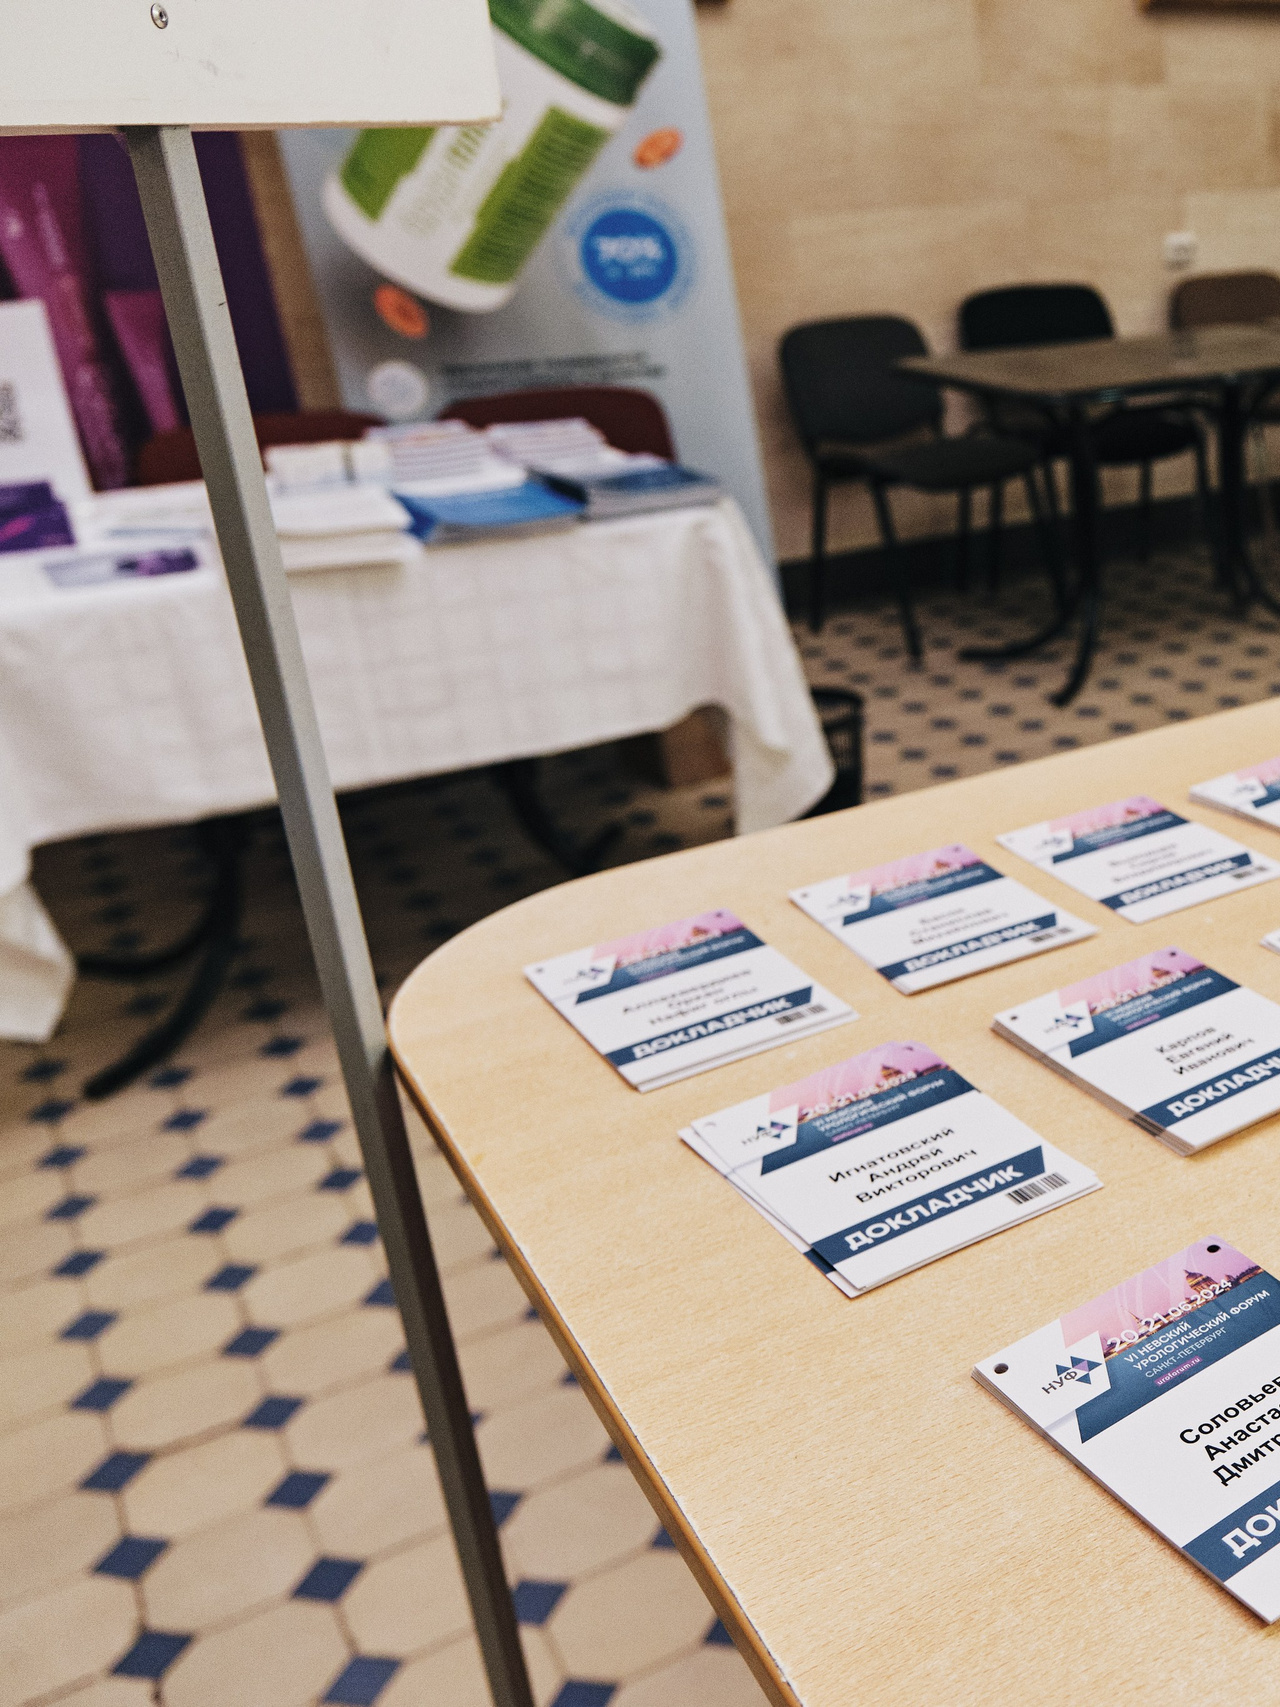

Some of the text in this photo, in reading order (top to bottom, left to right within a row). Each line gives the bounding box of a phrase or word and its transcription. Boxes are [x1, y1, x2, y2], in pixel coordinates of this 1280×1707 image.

[633, 998, 793, 1059] ДОКЛАДЧИК
[1156, 1026, 1216, 1054] Карпов
[1166, 1033, 1234, 1063] Евгений
[1173, 1038, 1254, 1075] Иванович
[829, 1126, 955, 1184] Игнатовский
[856, 1149, 977, 1204] Викторович
[869, 1146, 944, 1182] Андрей
[844, 1164, 1024, 1252] ДОКЛАДЧИК
[1107, 1279, 1232, 1352] 20-21.06.2024
[1133, 1289, 1270, 1371] УРОЛОГИЧЕСКИЙ ФОРУМ
[1124, 1321, 1192, 1364] VI НЕВСКИЙ
[1145, 1326, 1226, 1378] САНКТ-ПЕТЕРБУРГ
[1042, 1370, 1077, 1394] НУФ
[1157, 1357, 1200, 1385] uroforum.ru
